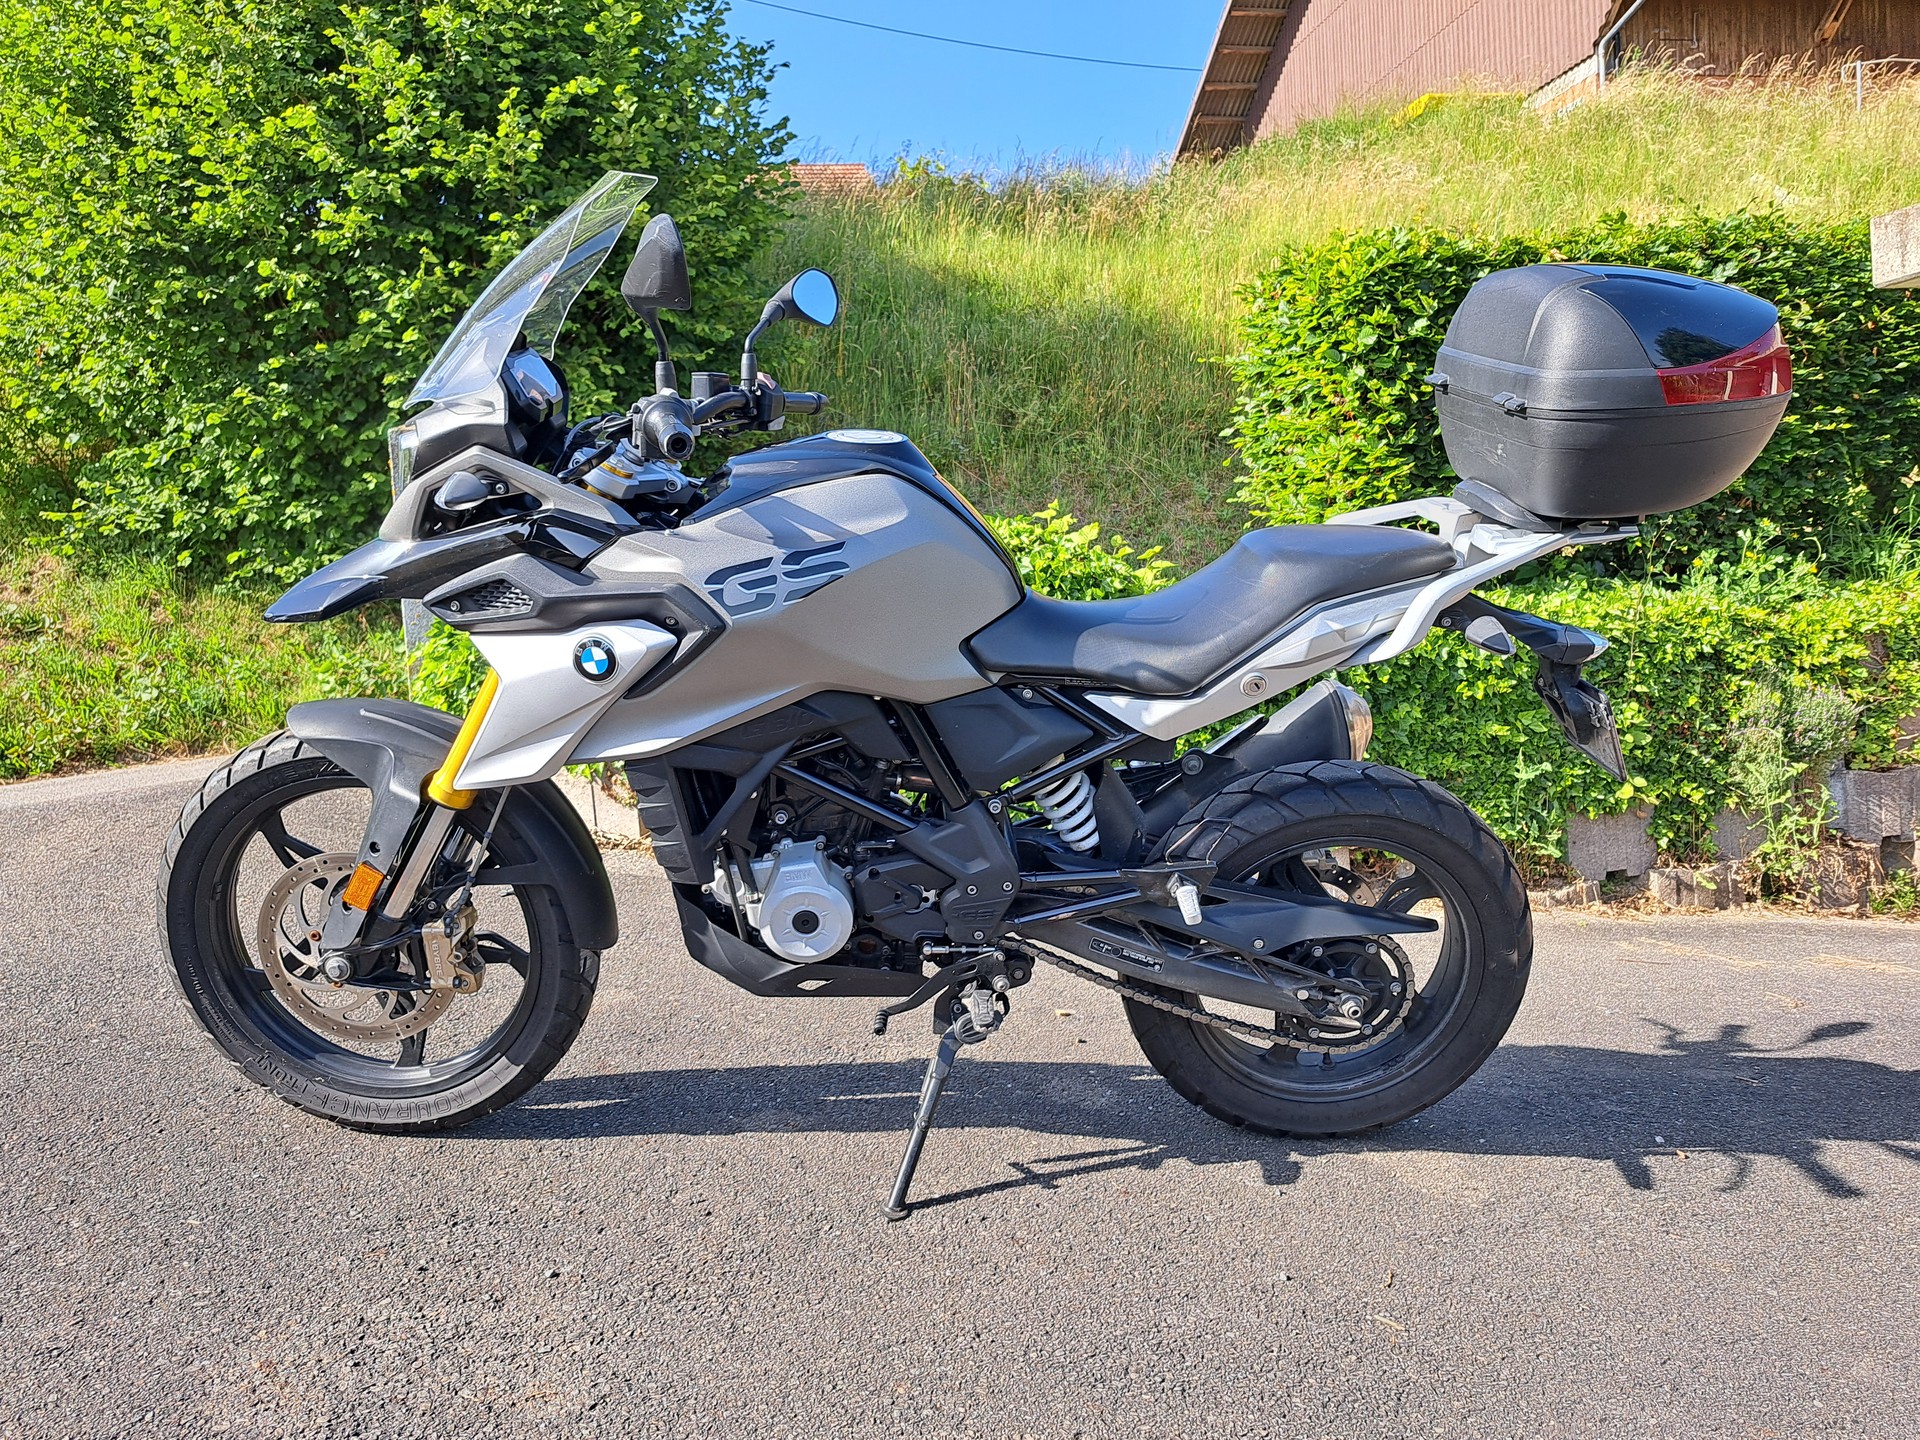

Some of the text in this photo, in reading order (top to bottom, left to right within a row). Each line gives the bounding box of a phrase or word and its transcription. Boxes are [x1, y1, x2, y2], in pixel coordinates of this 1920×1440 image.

[703, 541, 851, 619] GS
[576, 639, 610, 656] BMW
[431, 943, 443, 976] BYBRE
[311, 1088, 473, 1120] TOURANCE
